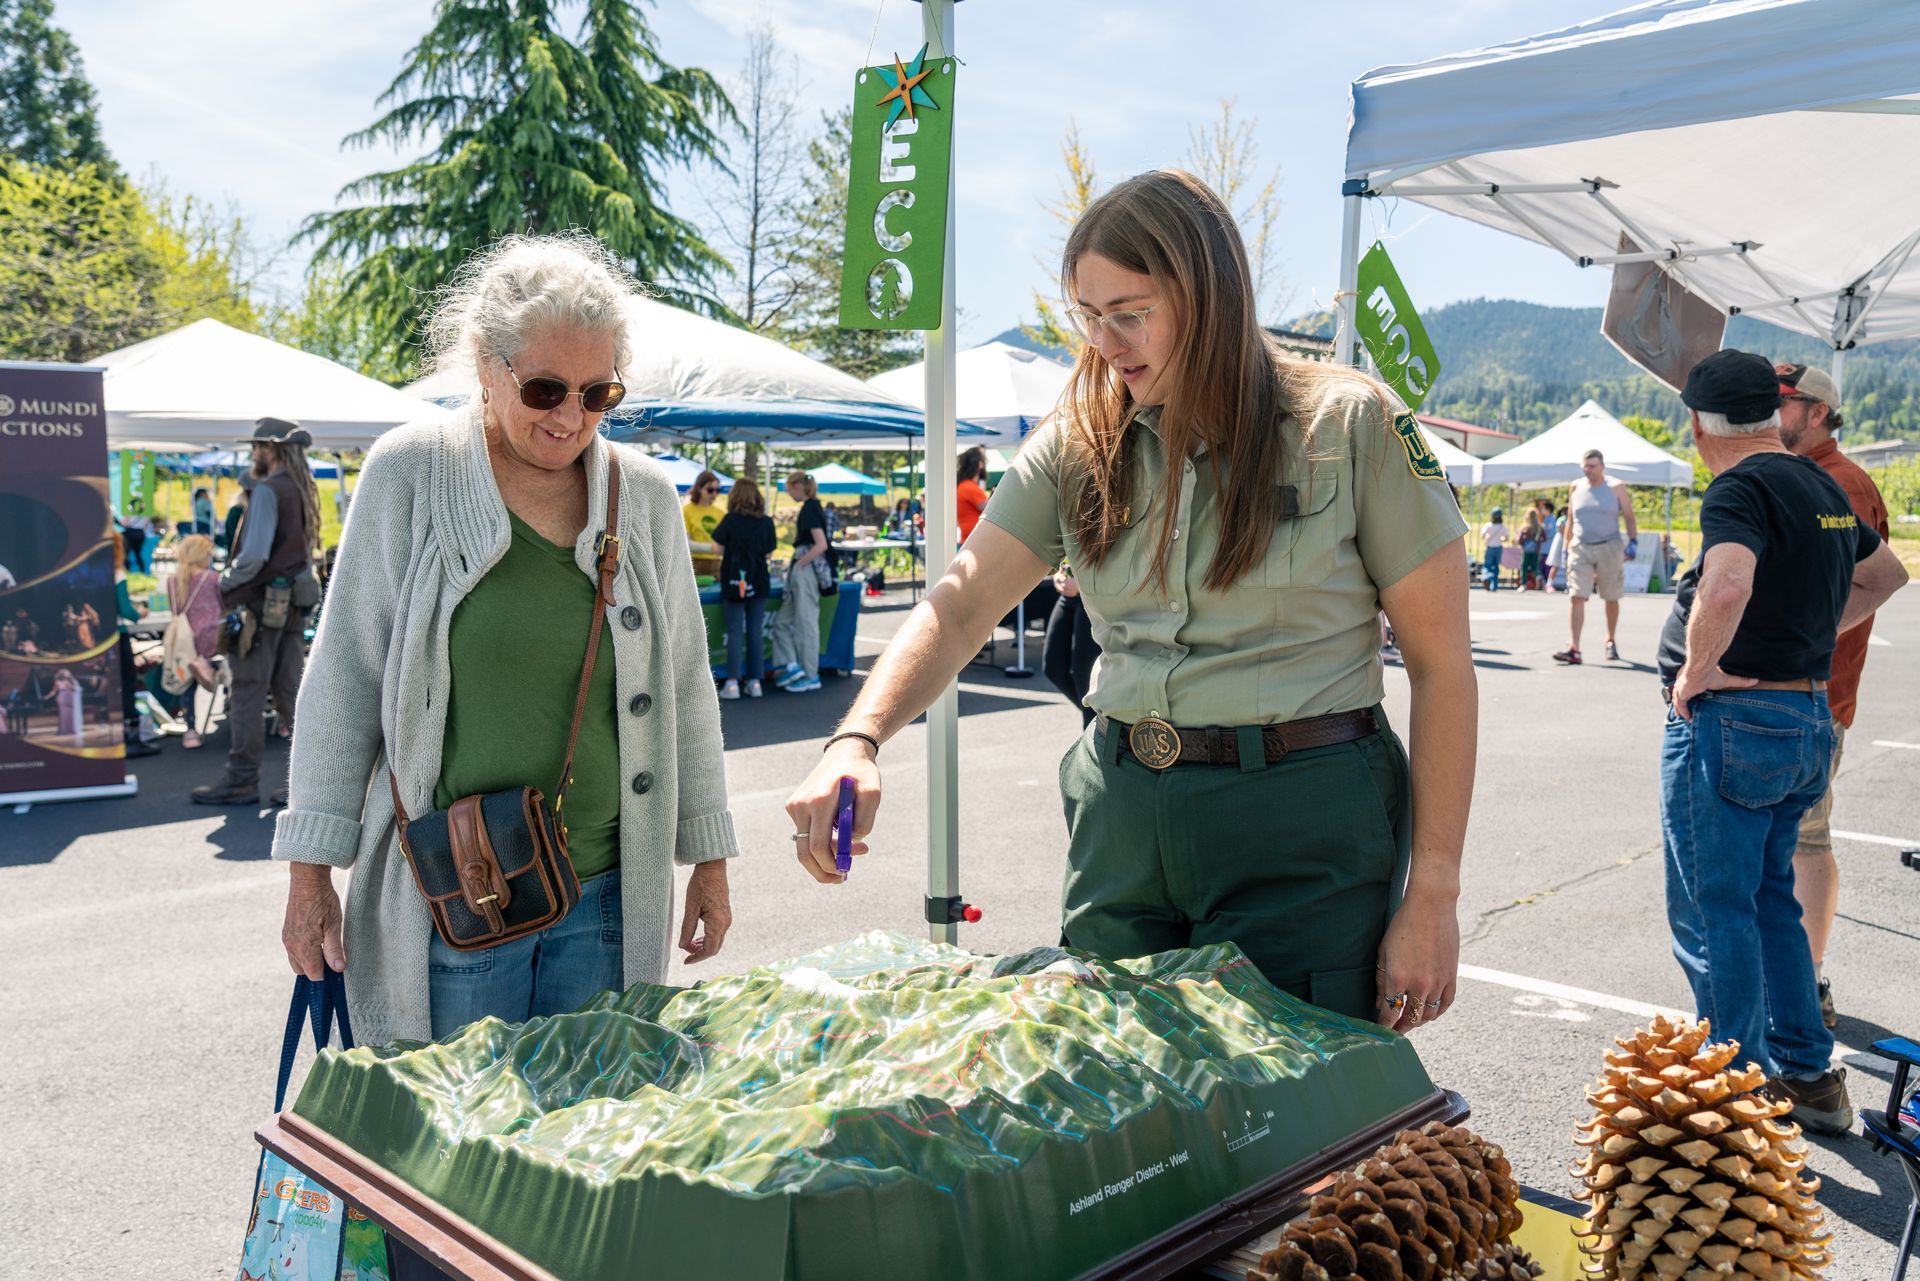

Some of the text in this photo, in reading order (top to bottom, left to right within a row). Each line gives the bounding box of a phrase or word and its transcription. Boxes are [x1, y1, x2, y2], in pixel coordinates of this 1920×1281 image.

[865, 117, 919, 321] ECO
[20, 398, 98, 416] MUNDI
[0, 420, 84, 437] CTIONS
[1070, 1188, 1103, 1216] Ashland
[1104, 1176, 1135, 1198] Ranger
[1136, 1161, 1164, 1183] District
[1169, 1149, 1189, 1167] West
